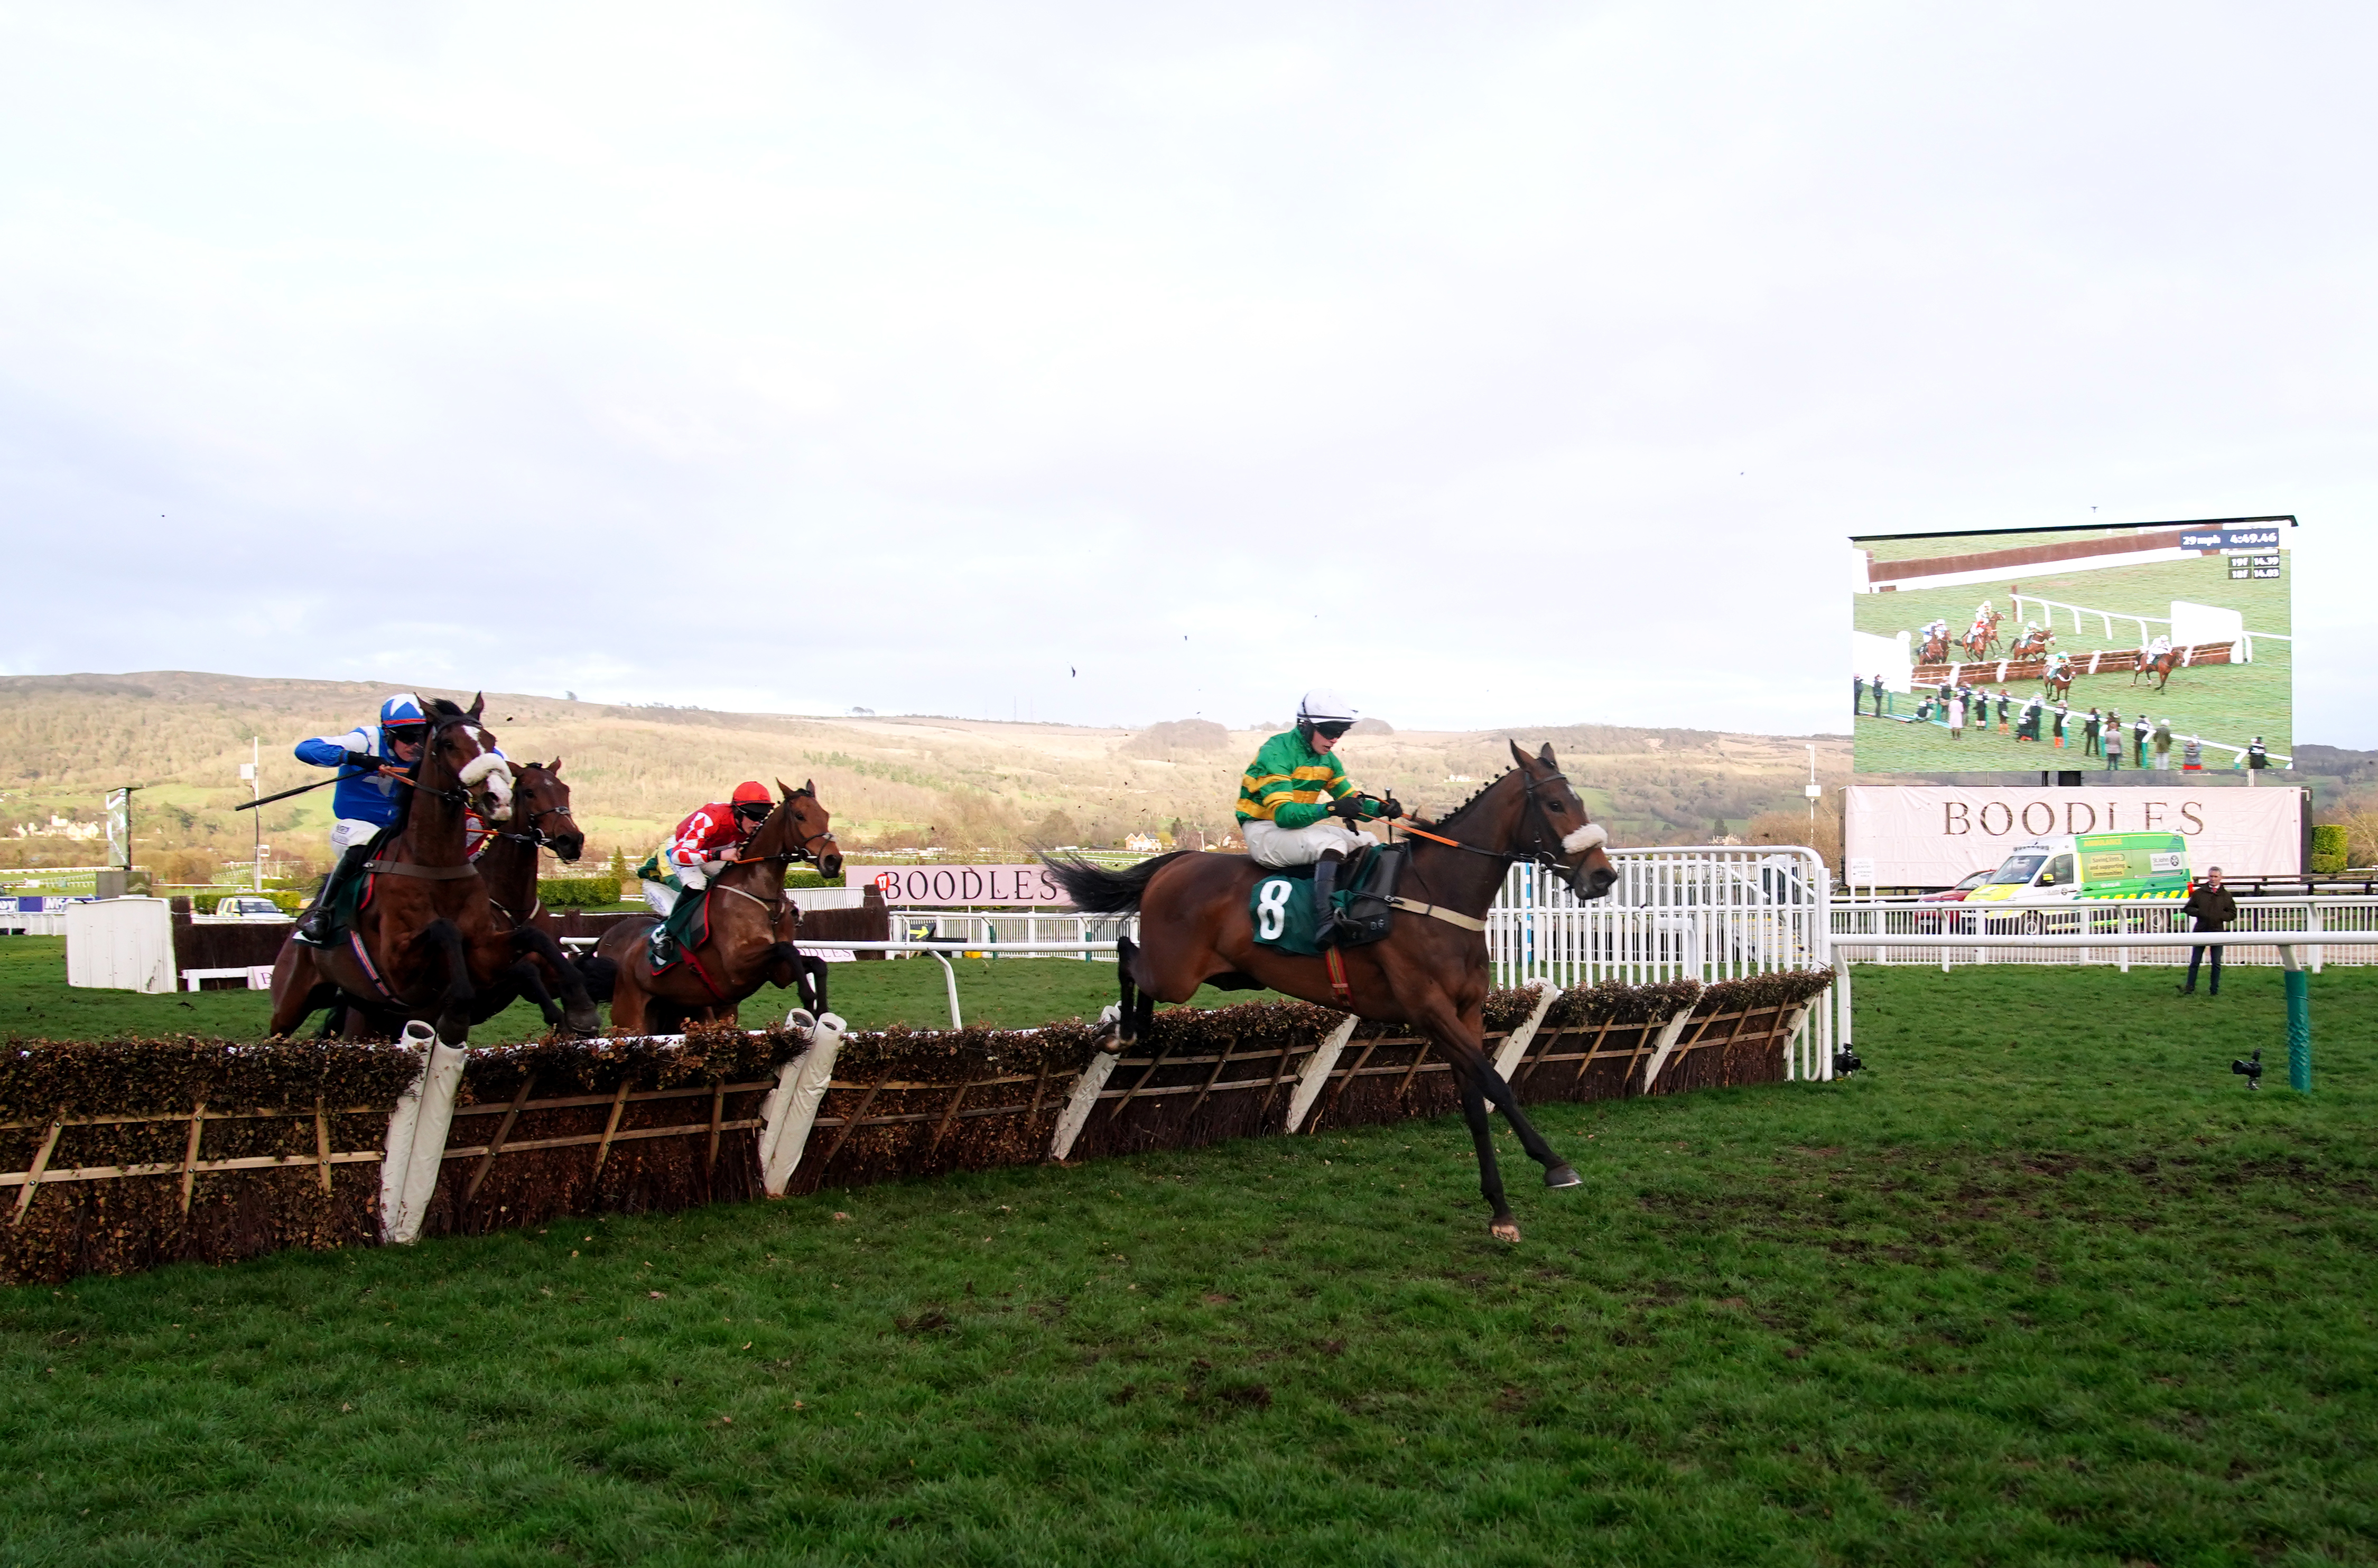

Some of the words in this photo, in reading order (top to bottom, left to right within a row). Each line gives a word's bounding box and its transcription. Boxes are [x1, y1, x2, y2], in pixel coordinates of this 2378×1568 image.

[2182, 536, 2197, 545] 29
[2197, 535, 2221, 546] mph
[2230, 532, 2277, 544] 4:49.46
[2231, 557, 2248, 566] 19f
[2254, 556, 2279, 565] 14.39
[2232, 569, 2248, 578] 18f
[2254, 568, 2280, 577] 14.03
[1943, 801, 2204, 836] BOODLES
[2084, 838, 2122, 847] AMBULANCE
[877, 875, 887, 889] 17
[883, 871, 1057, 900] BOODLES
[1257, 880, 1293, 939] 8
